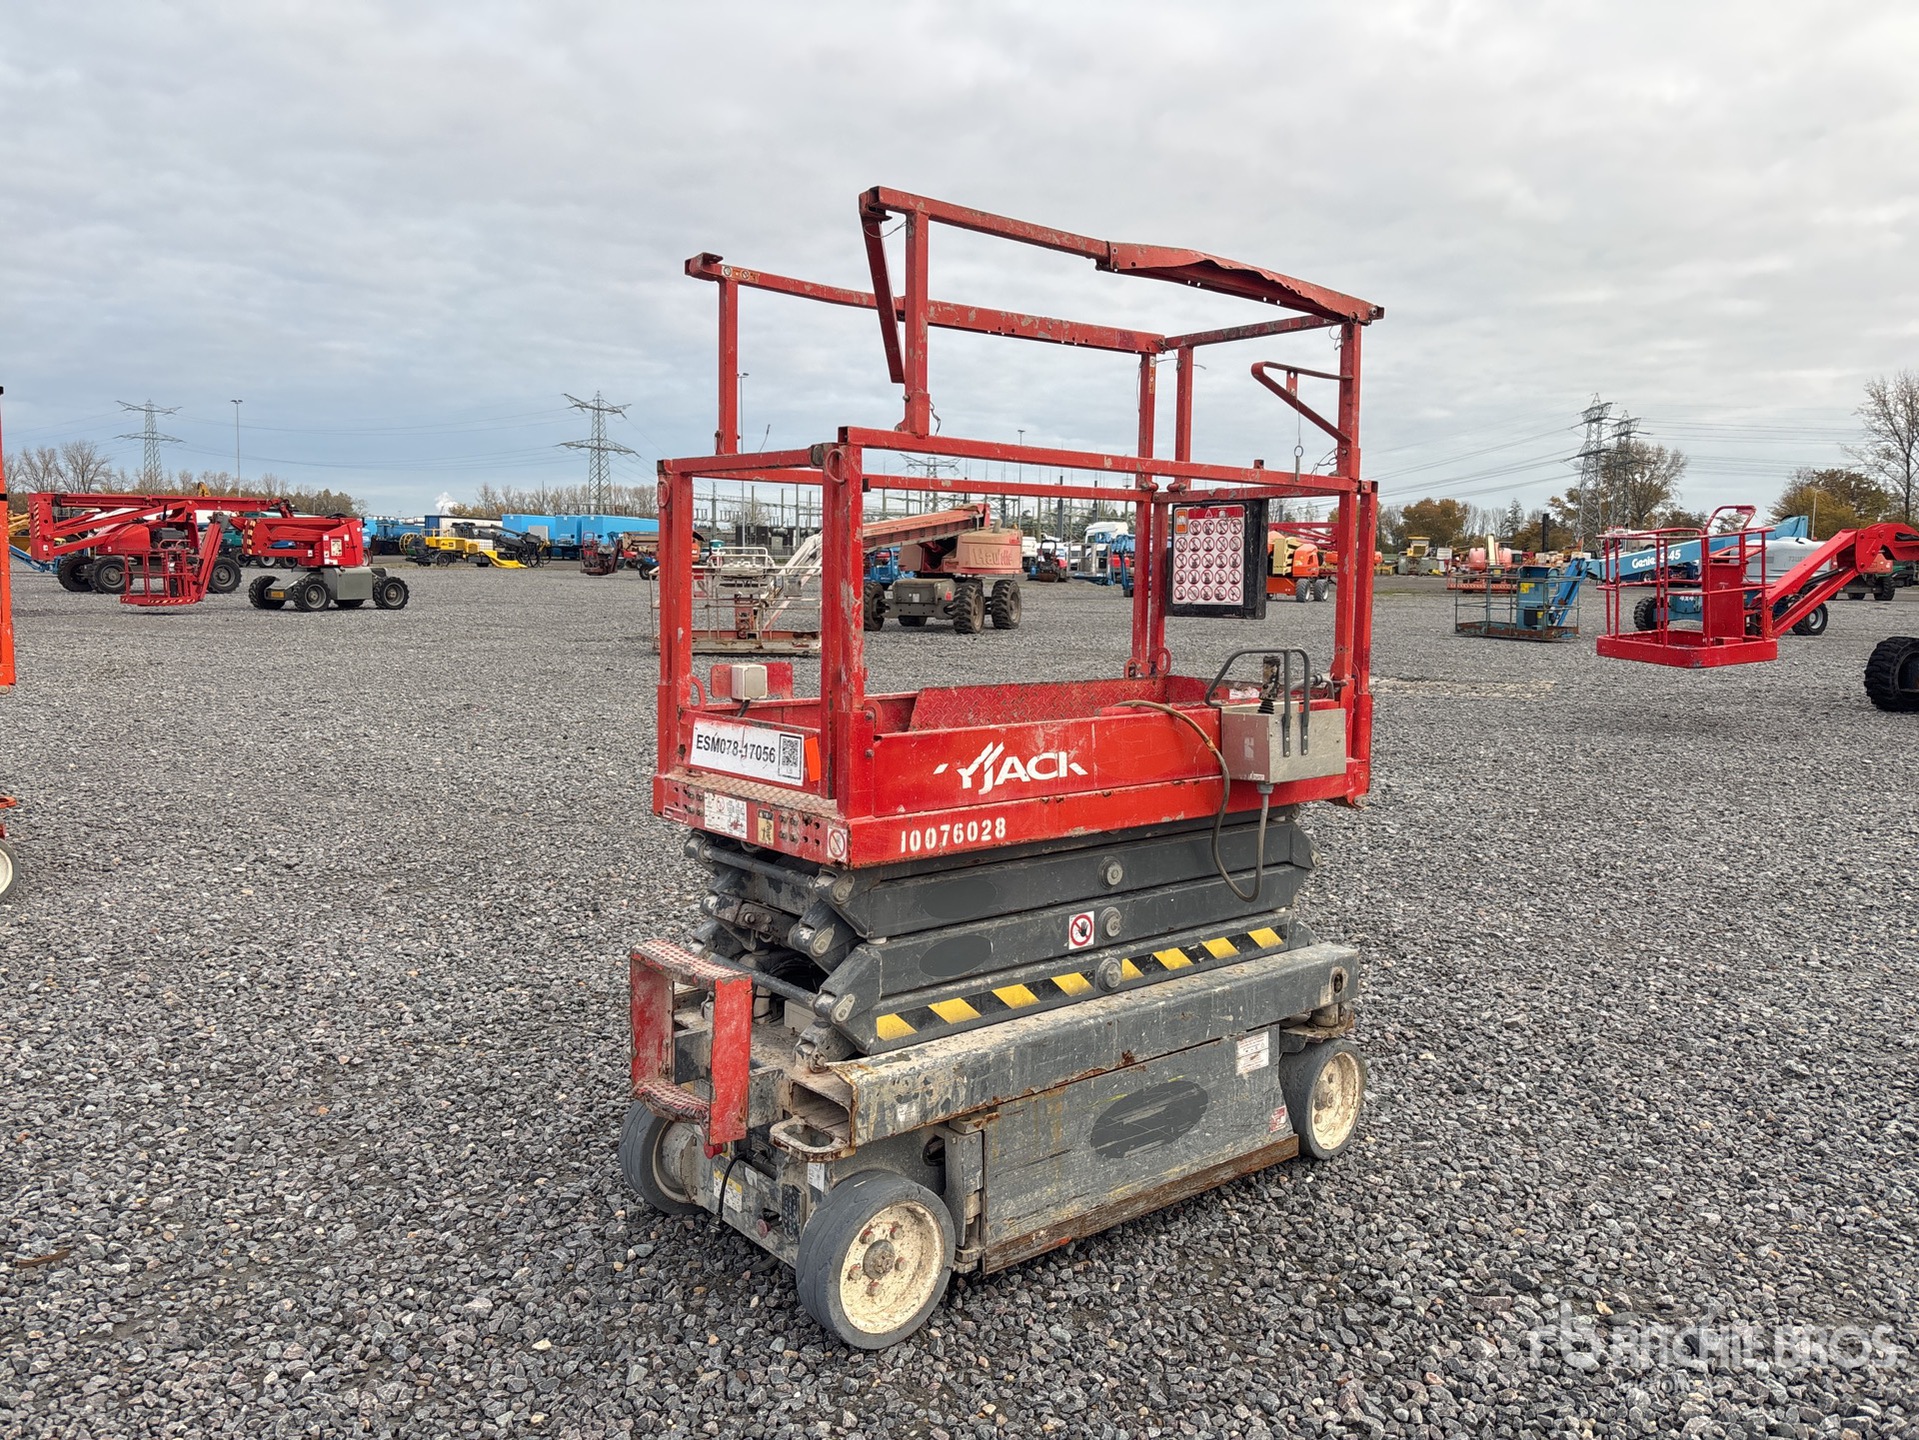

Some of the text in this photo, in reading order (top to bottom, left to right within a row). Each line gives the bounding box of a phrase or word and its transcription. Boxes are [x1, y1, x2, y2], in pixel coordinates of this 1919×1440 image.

[1631, 555, 1657, 569] Genie
[696, 733, 776, 764] ESM078-17056
[900, 816, 1006, 853] 10076028
